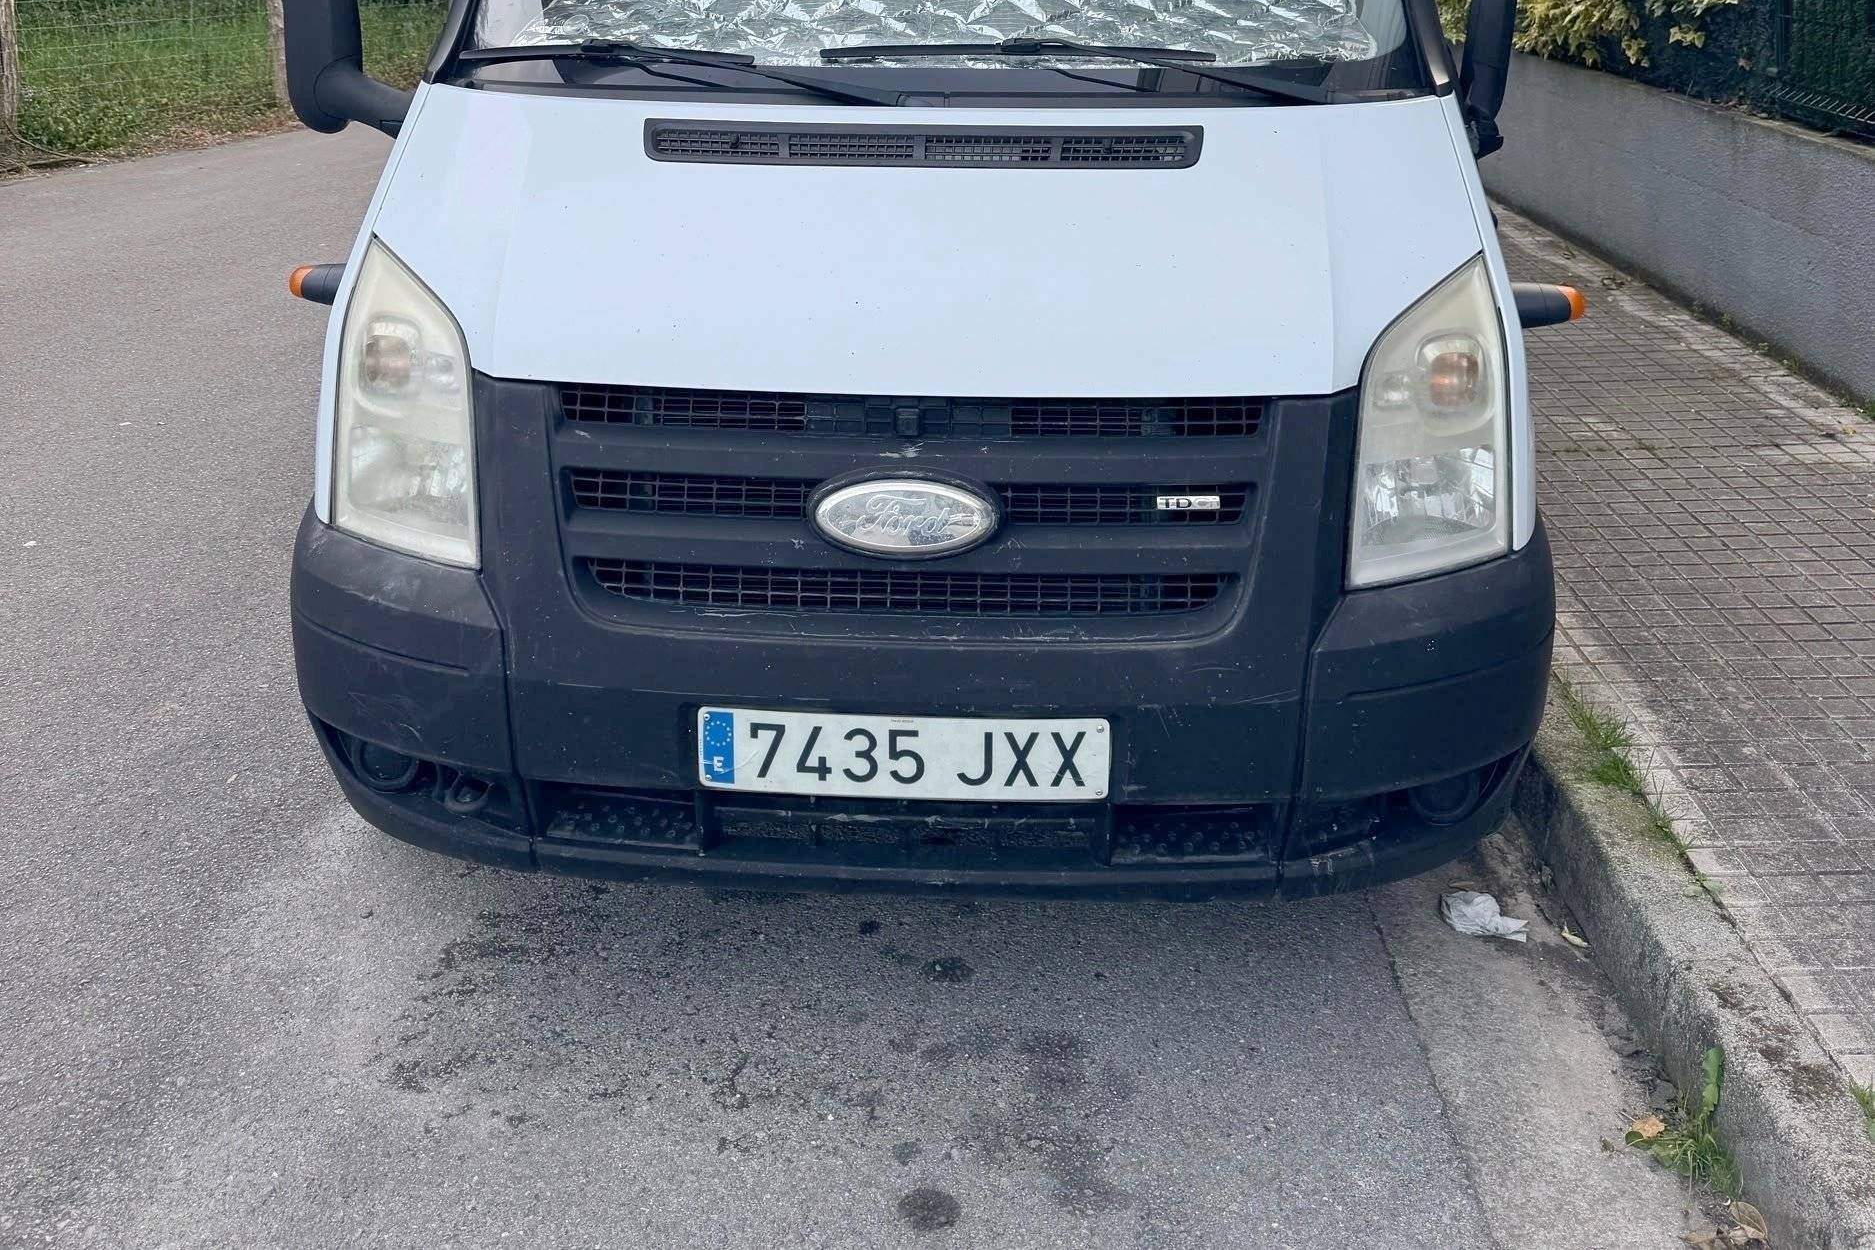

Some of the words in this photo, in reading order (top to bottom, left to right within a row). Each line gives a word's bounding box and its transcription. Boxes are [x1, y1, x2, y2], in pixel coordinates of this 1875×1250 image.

[852, 494, 951, 536] Ford
[713, 756, 725, 772] E
[749, 722, 925, 784] 7435
[956, 731, 1086, 787] JXX
